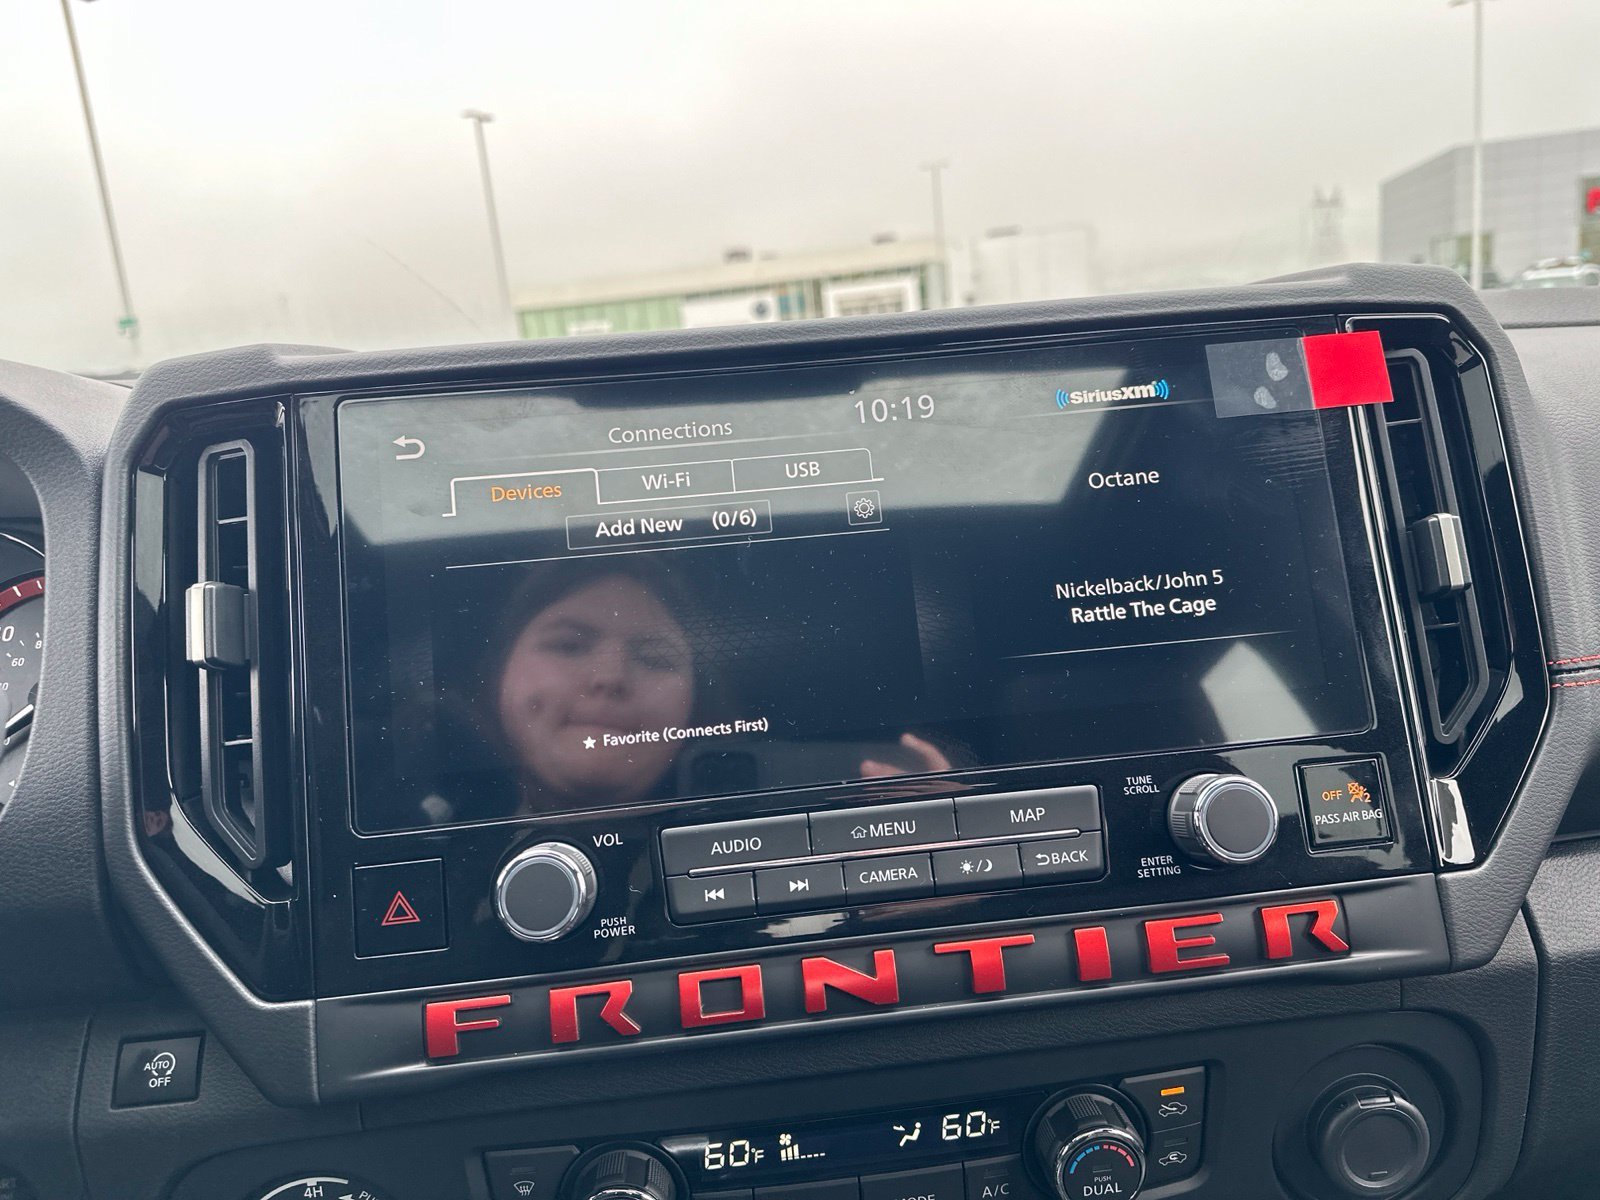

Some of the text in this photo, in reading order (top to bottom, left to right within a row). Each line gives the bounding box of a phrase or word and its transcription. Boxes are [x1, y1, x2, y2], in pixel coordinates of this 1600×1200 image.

[855, 394, 935, 425] 10:19
[608, 421, 732, 444] Connections
[785, 461, 821, 479] USB
[641, 472, 691, 491] Wi-Fi
[1088, 470, 1160, 489] Octane
[490, 483, 563, 503] Devices
[595, 508, 757, 538] Add New (0/6)
[1055, 569, 1224, 599] Nickelback/John 5
[1071, 597, 1217, 624] Rattle The Cage
[0, 626, 15, 642] 0
[11, 657, 25, 667] 60
[603, 717, 769, 747] Favorite (Connects First)
[1126, 775, 1153, 786] TUNE
[1123, 784, 1160, 796] SCROLL
[1321, 790, 1342, 801] OFF
[1010, 807, 1046, 824] MAP
[1314, 808, 1383, 825] PASS AIR BAG
[870, 820, 916, 838] MENU
[593, 833, 624, 848] VOL
[711, 837, 762, 856] AUDIO
[1052, 850, 1089, 865] BACK
[1140, 855, 1173, 867] ENTER
[859, 866, 918, 885] CAMERA
[1137, 865, 1181, 879] SETTING
[600, 916, 627, 928] PUSH
[594, 924, 636, 939] POWER
[424, 898, 1351, 1059] FRONTIER
[143, 1060, 170, 1071] AUTO
[149, 1076, 171, 1088] OFF
[1094, 1174, 1112, 1182] PUSH
[303, 1185, 323, 1198] 4H
[982, 1182, 1010, 1199] A/C
[1083, 1184, 1122, 1197] DUAL
